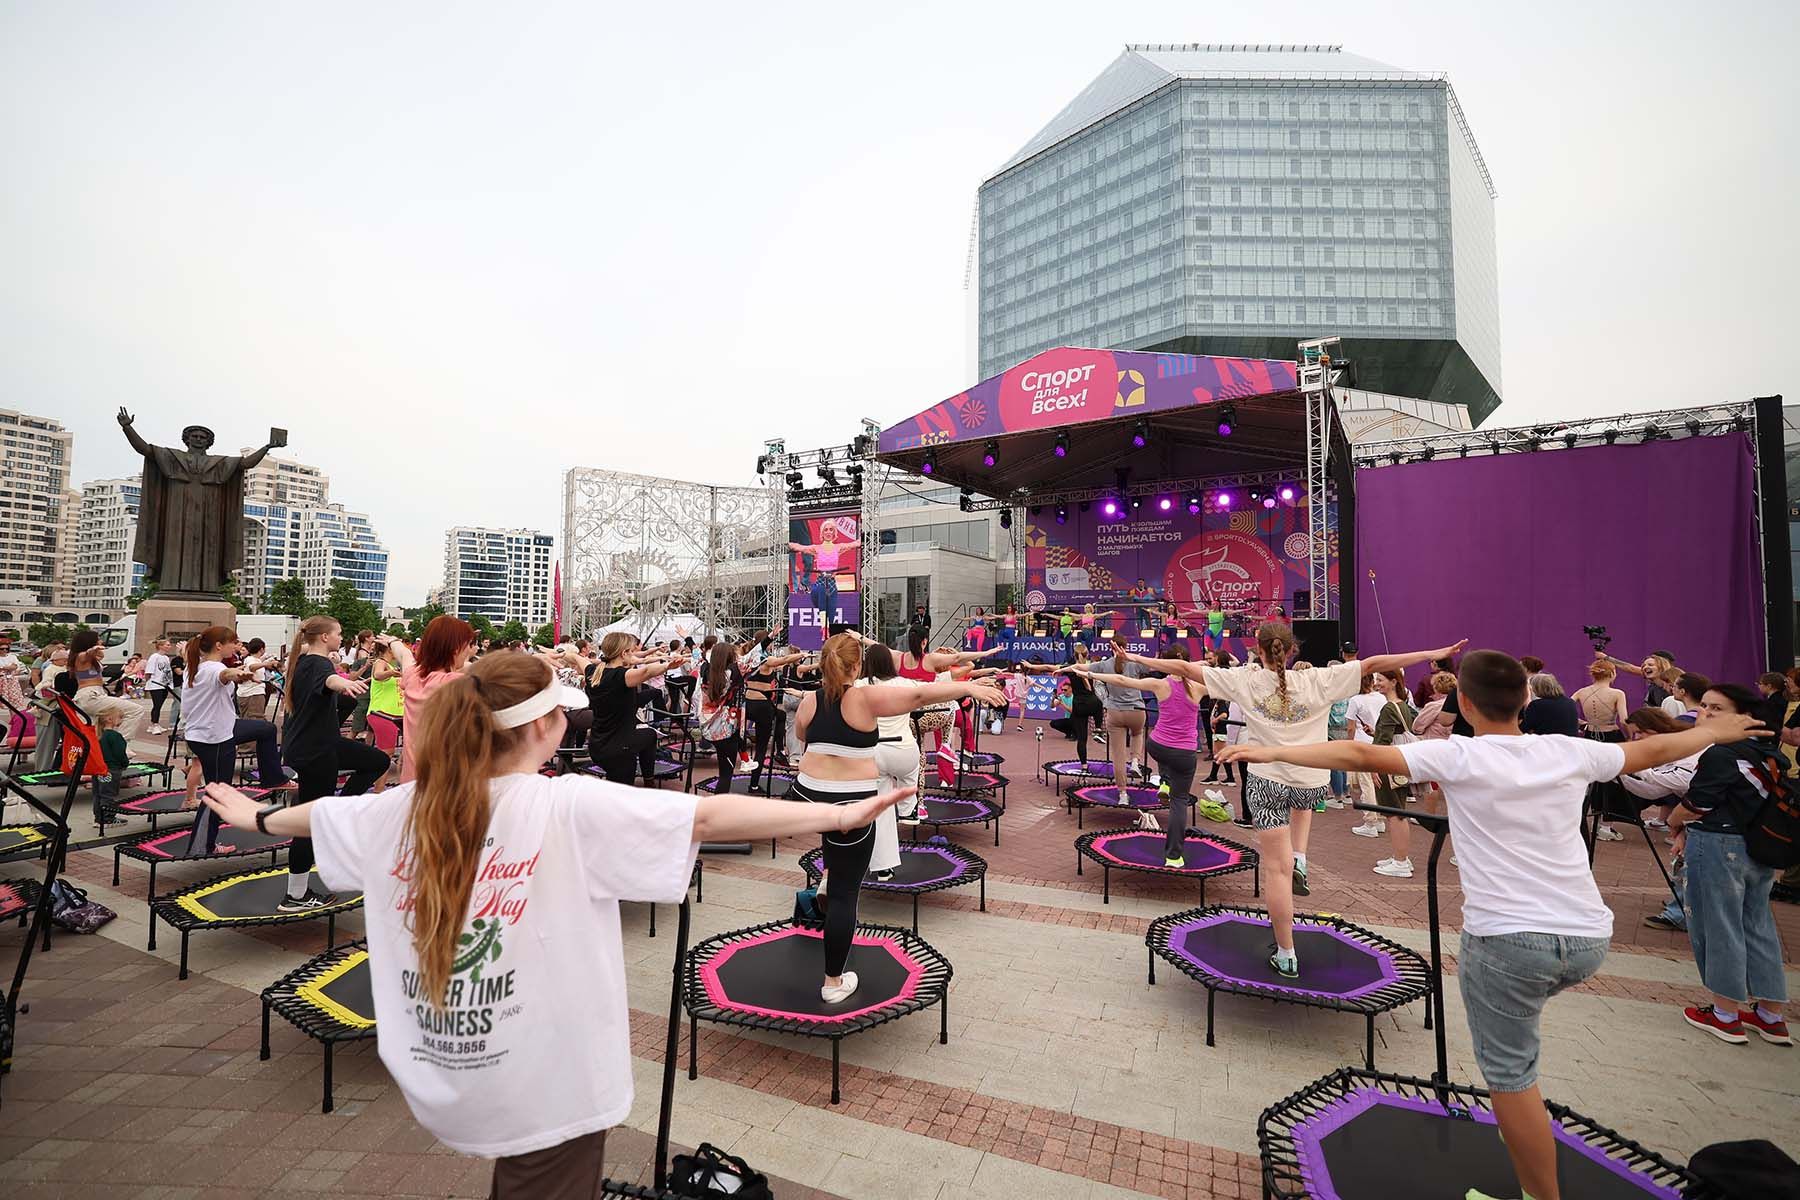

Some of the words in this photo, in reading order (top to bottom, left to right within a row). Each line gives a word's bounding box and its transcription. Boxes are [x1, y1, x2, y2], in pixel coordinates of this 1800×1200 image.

[1021, 364, 1096, 391] Спорт
[1034, 387, 1060, 400] для
[1097, 524, 1130, 534] ПУТЬ
[1097, 531, 1182, 545] НАЧИНАЕТСЯ
[1211, 580, 1262, 595] Спорт
[477, 846, 542, 882] heart
[473, 880, 528, 925] Way
